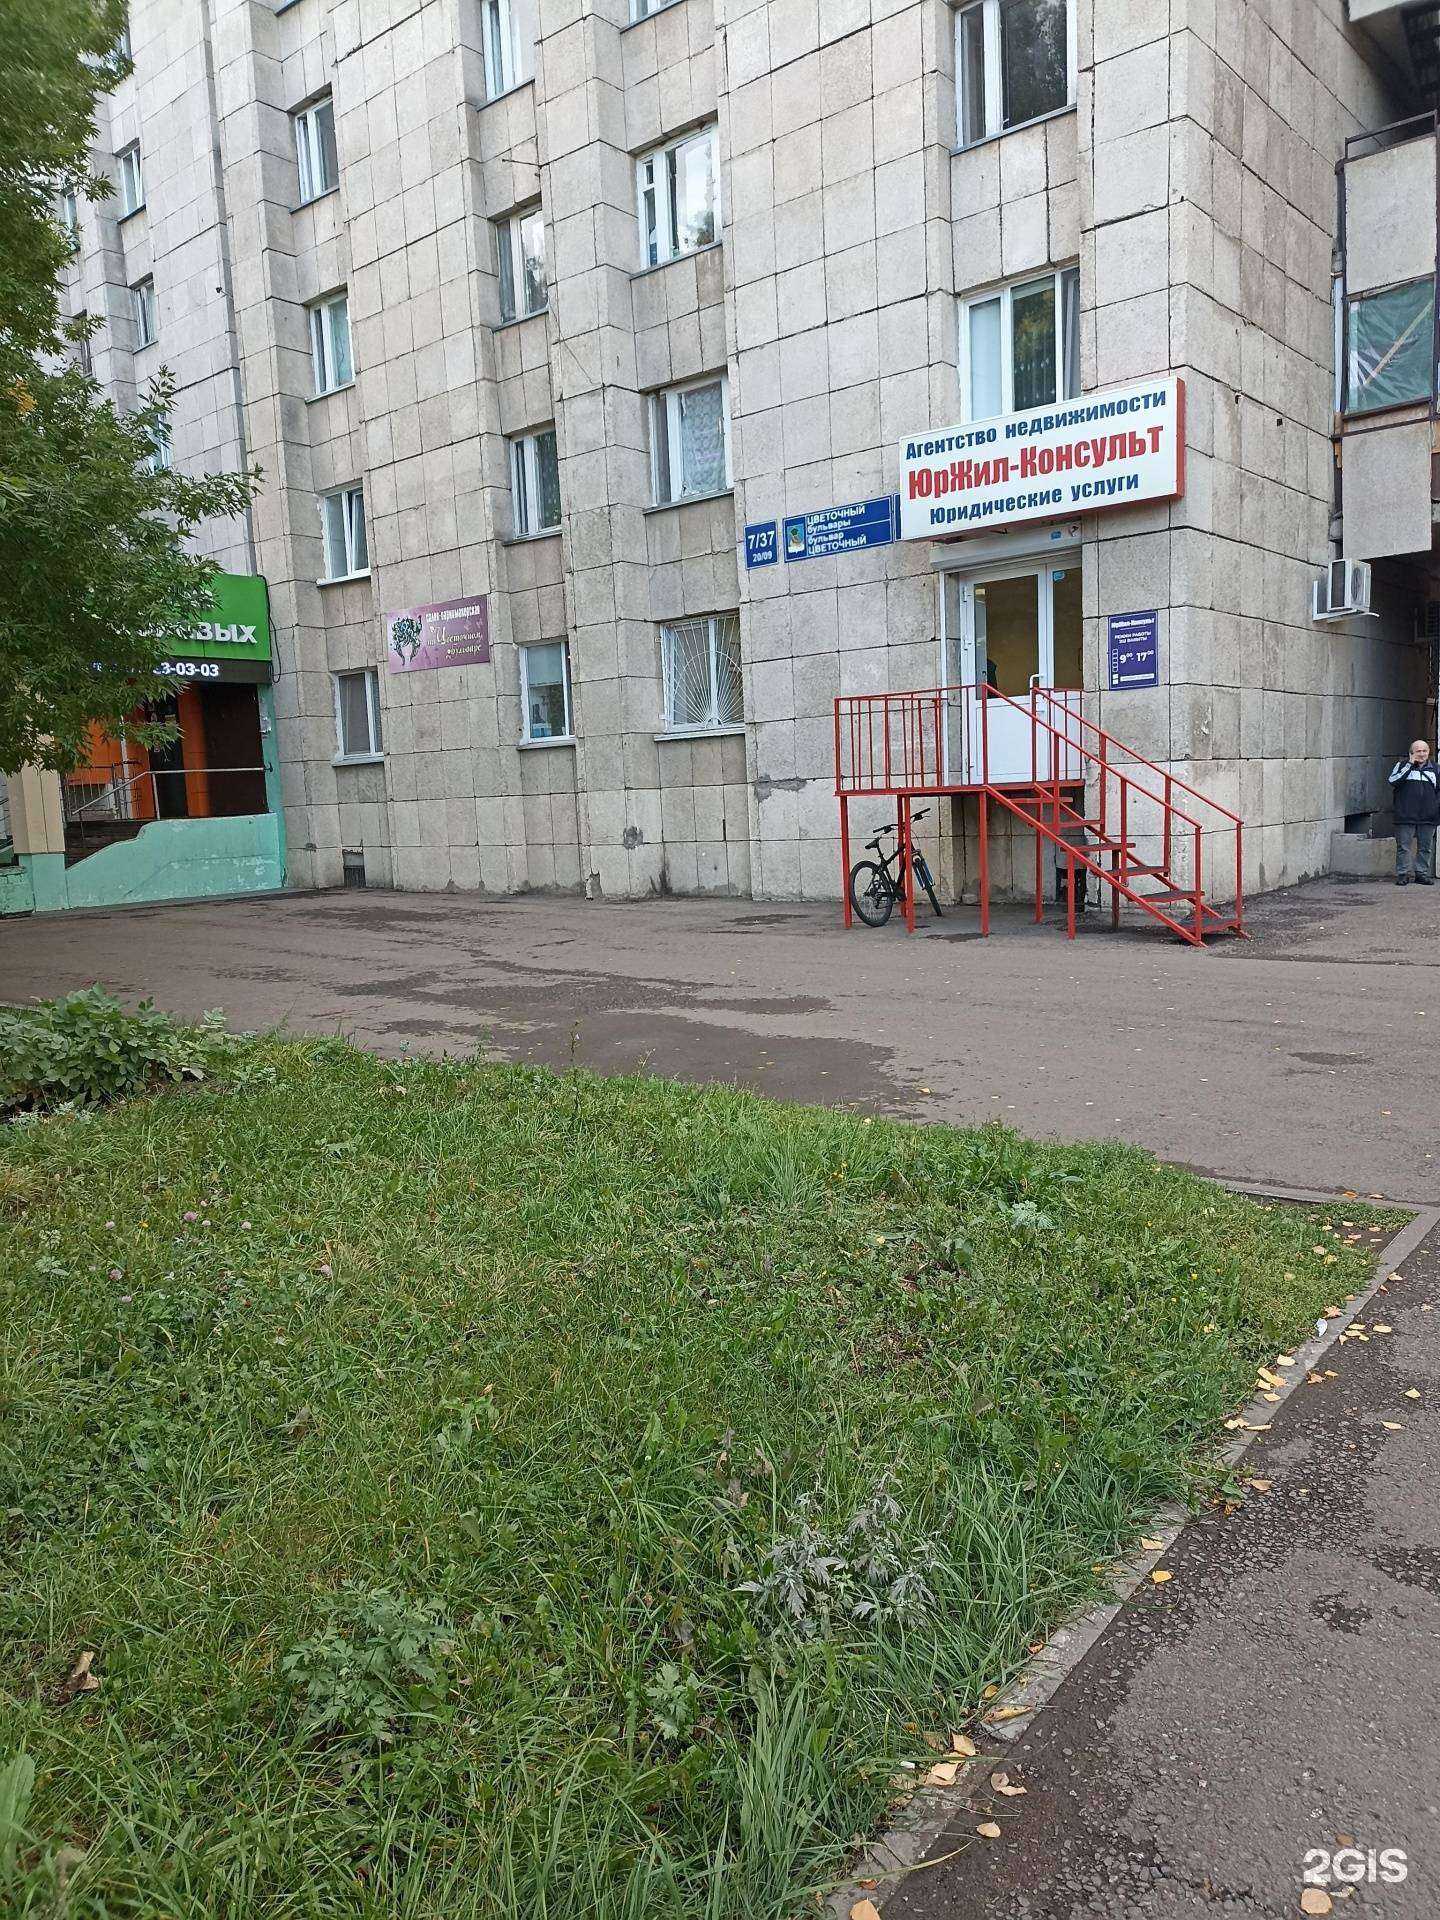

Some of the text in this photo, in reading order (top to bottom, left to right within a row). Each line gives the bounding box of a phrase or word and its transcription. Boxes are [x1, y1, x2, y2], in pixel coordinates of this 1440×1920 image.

[906, 391, 1166, 460] Агентство недвижимости
[909, 425, 1164, 500] ЮрЖил-Консульт
[930, 474, 1139, 525] Юридические услуги
[807, 505, 865, 525] ЦВЕТОЧНЫЙ
[807, 519, 851, 534] бульвары
[748, 530, 775, 549] 7/37
[807, 532, 844, 546] бульвар
[808, 534, 867, 555] ЦВЕТОЧНЫЙ
[752, 551, 773, 562] 20/09
